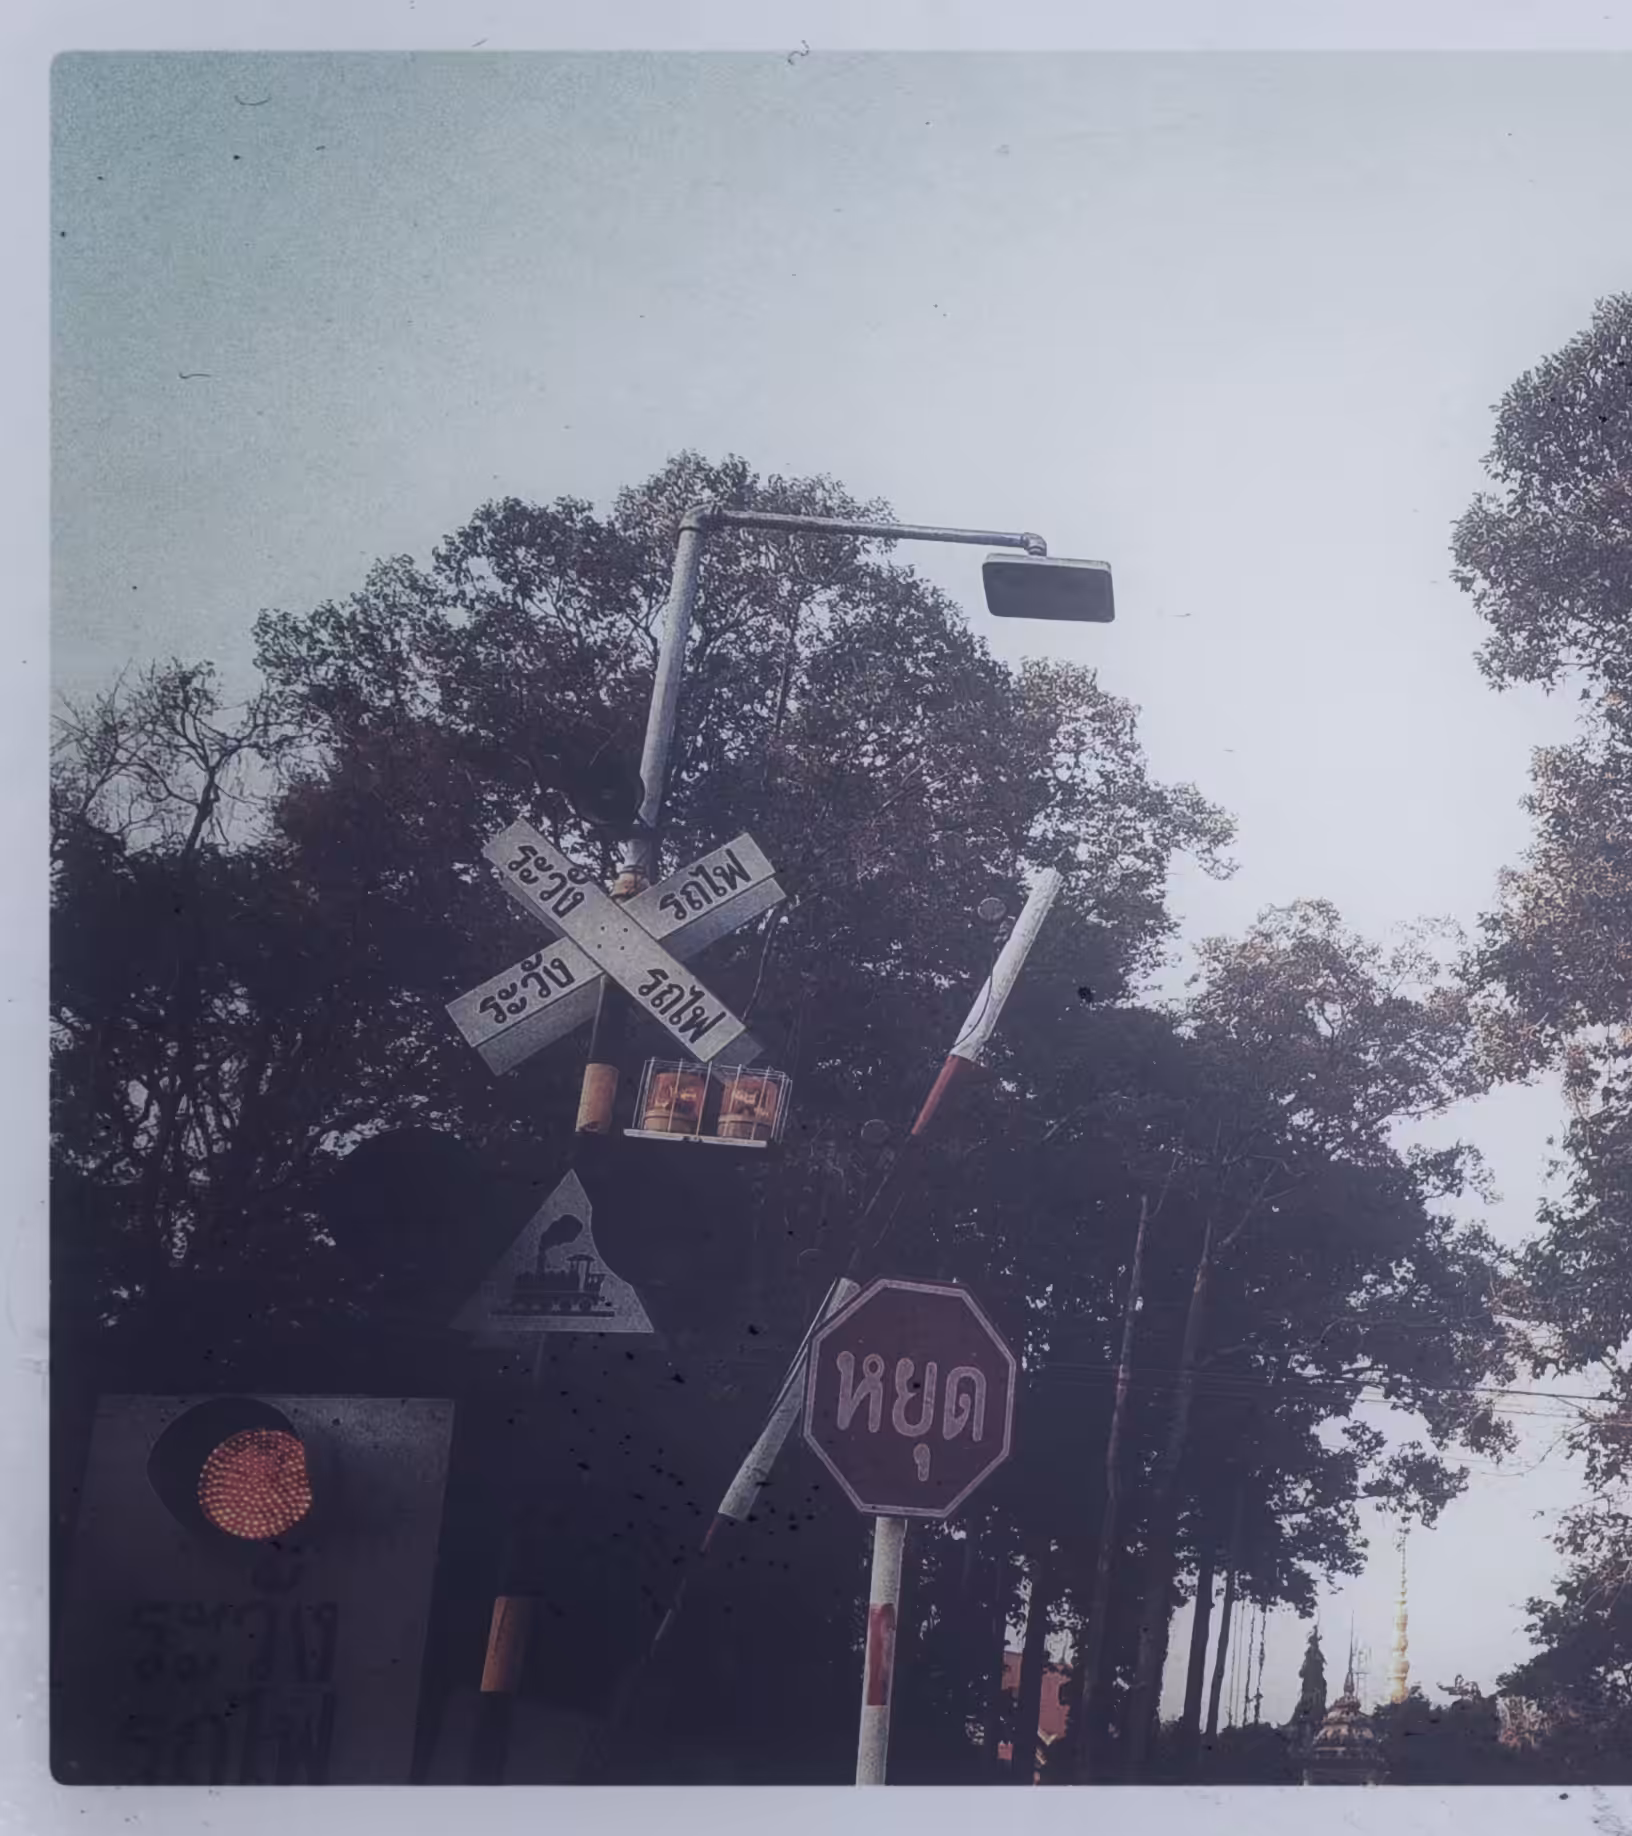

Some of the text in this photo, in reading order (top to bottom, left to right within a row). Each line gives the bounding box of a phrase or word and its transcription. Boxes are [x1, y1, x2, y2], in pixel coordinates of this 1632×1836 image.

[477, 848, 753, 1024] ระวัง รถไฟ
[507, 844, 728, 1044] ระวัง รถไฟ
[836, 1350, 988, 1483] หยุด
